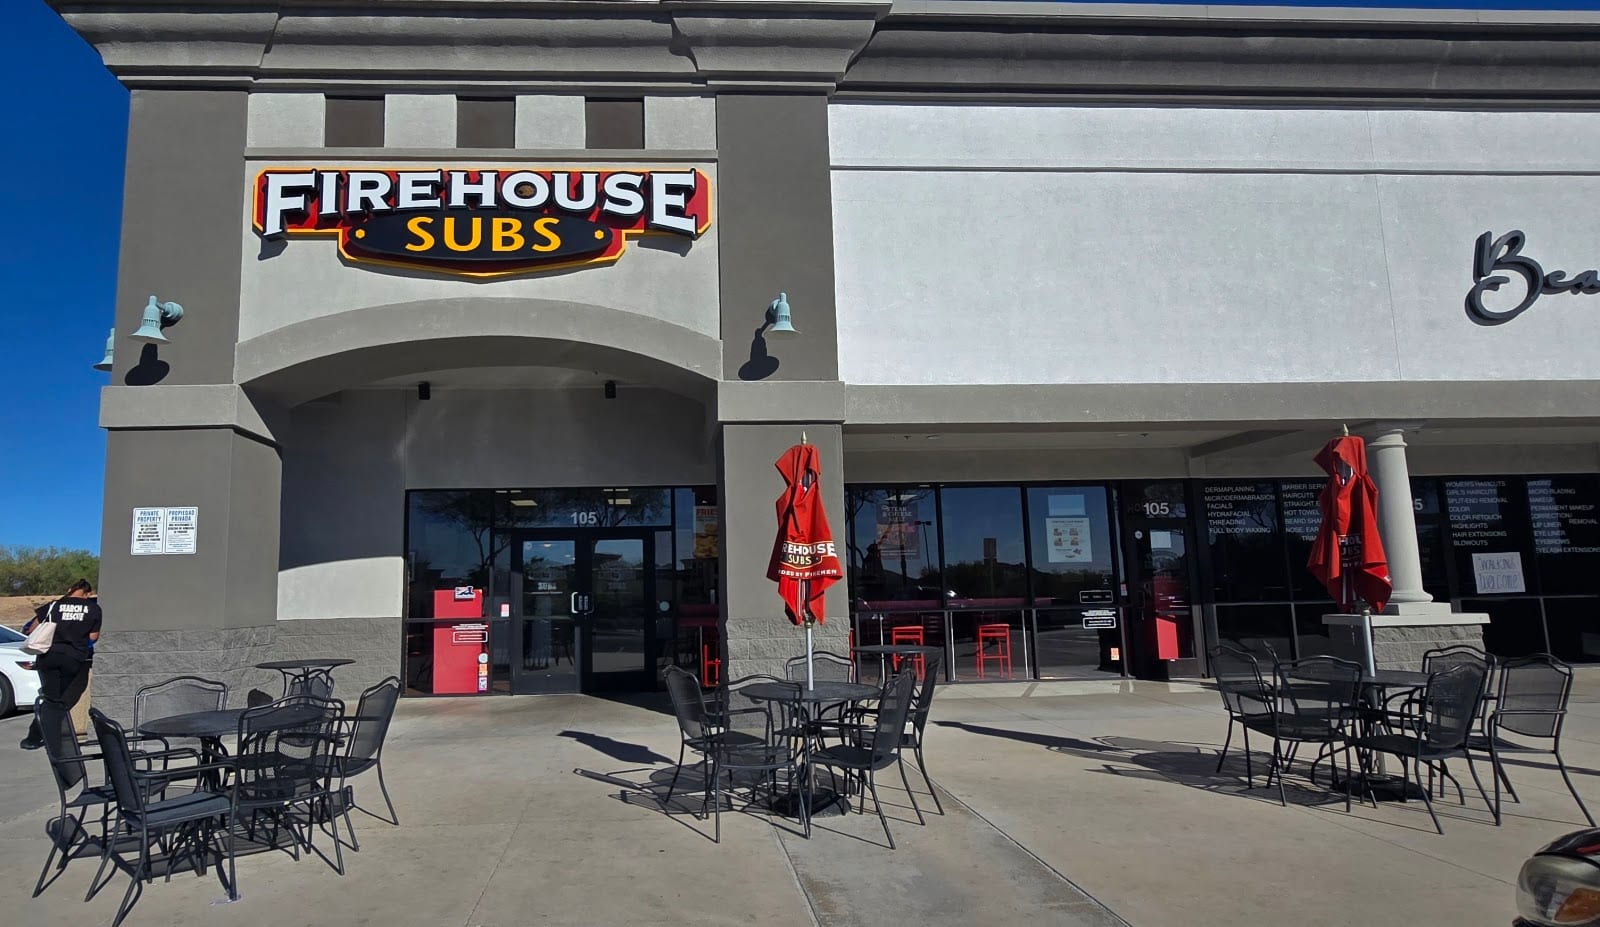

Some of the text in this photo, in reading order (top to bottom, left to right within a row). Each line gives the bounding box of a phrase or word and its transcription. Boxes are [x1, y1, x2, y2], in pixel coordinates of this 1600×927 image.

[262, 169, 697, 236] FIREHOUSE
[404, 215, 562, 253] SUBS
[1204, 494, 1276, 502] MICRODERMABRASION
[1143, 502, 1170, 515] 105
[1207, 502, 1233, 510] FACIALS
[571, 511, 598, 525] 105
[1208, 510, 1252, 518] HYDRAFACIAL
[788, 554, 812, 565] SUBS
[58, 604, 89, 614] SEARCH &
[61, 612, 85, 621] RESCUE
